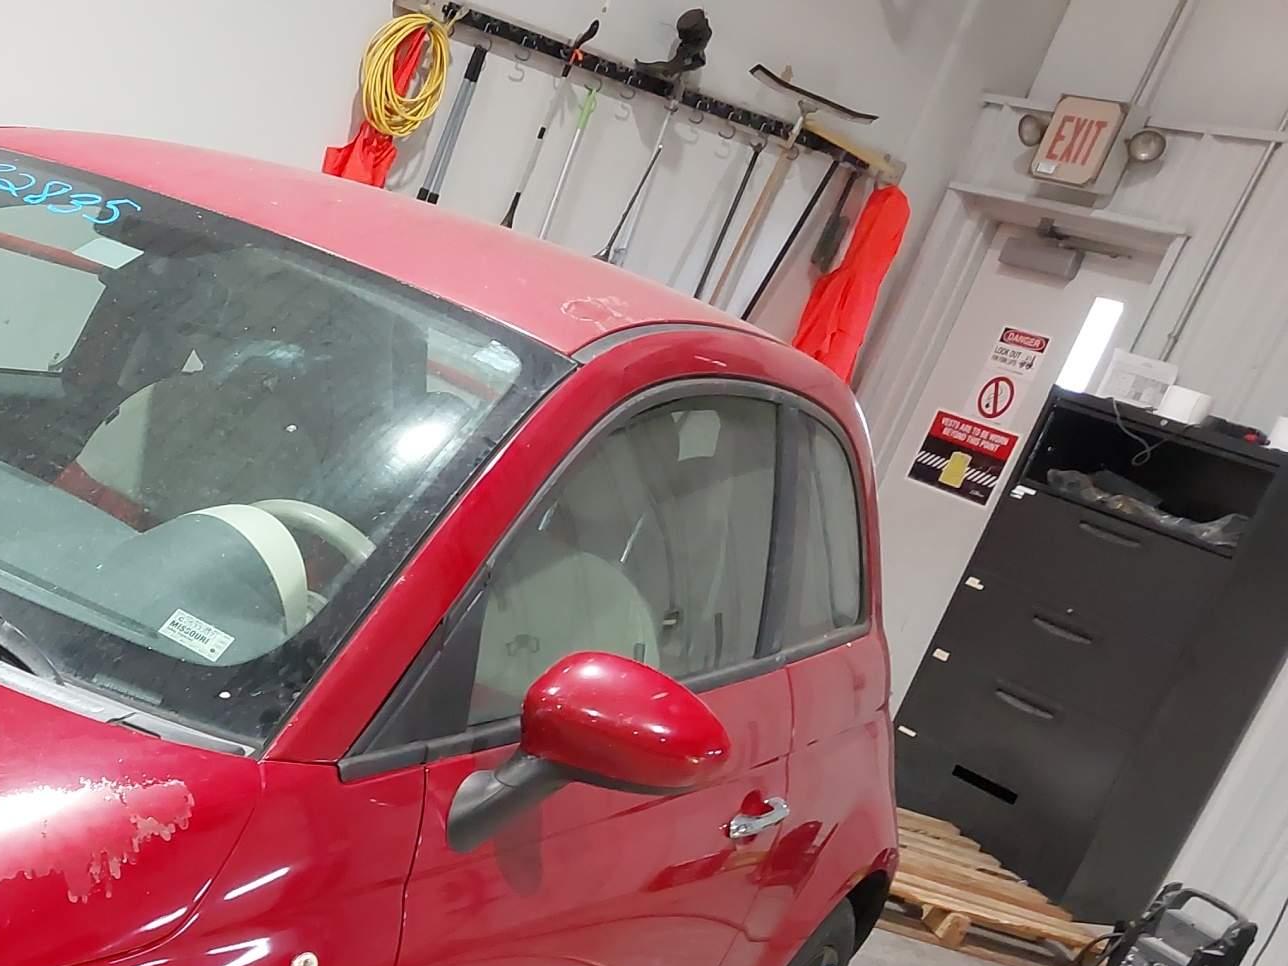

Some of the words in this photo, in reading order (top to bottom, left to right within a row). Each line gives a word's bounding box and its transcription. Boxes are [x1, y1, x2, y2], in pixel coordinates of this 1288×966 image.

[1045, 115, 1108, 166] EXIT
[1007, 332, 1041, 348] DANGER
[168, 619, 210, 645] MISSOURI
